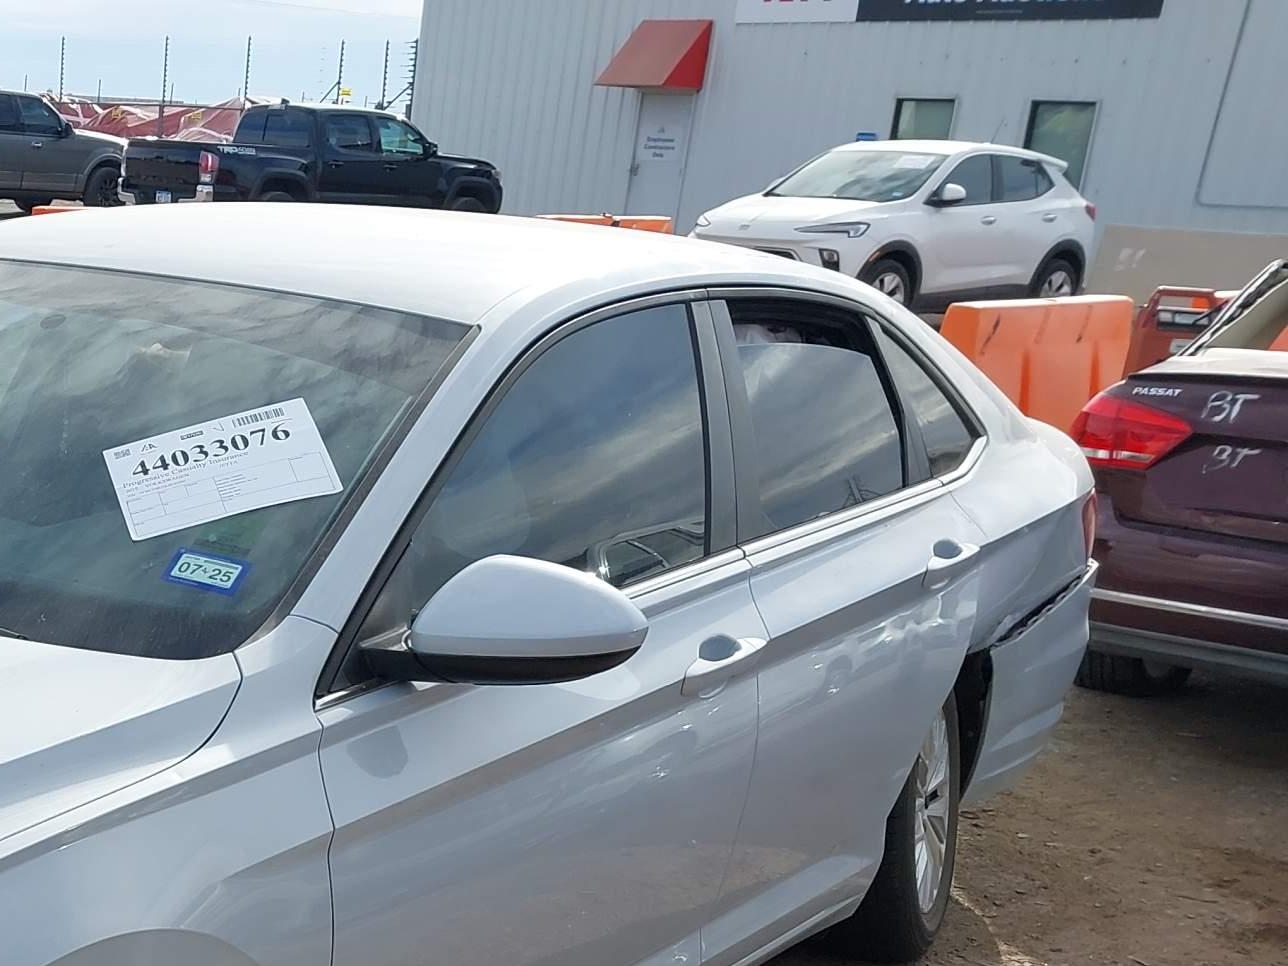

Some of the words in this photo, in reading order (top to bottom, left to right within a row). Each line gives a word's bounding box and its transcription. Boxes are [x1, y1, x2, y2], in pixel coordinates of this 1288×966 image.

[1132, 387, 1183, 397] PASSAT
[1200, 390, 1261, 424] BT
[132, 423, 292, 477] 44033076
[122, 472, 170, 489] Progressive
[171, 462, 207, 476] Casualty
[209, 451, 249, 466] Insurance
[178, 561, 203, 575] 07
[208, 568, 234, 583] 25
